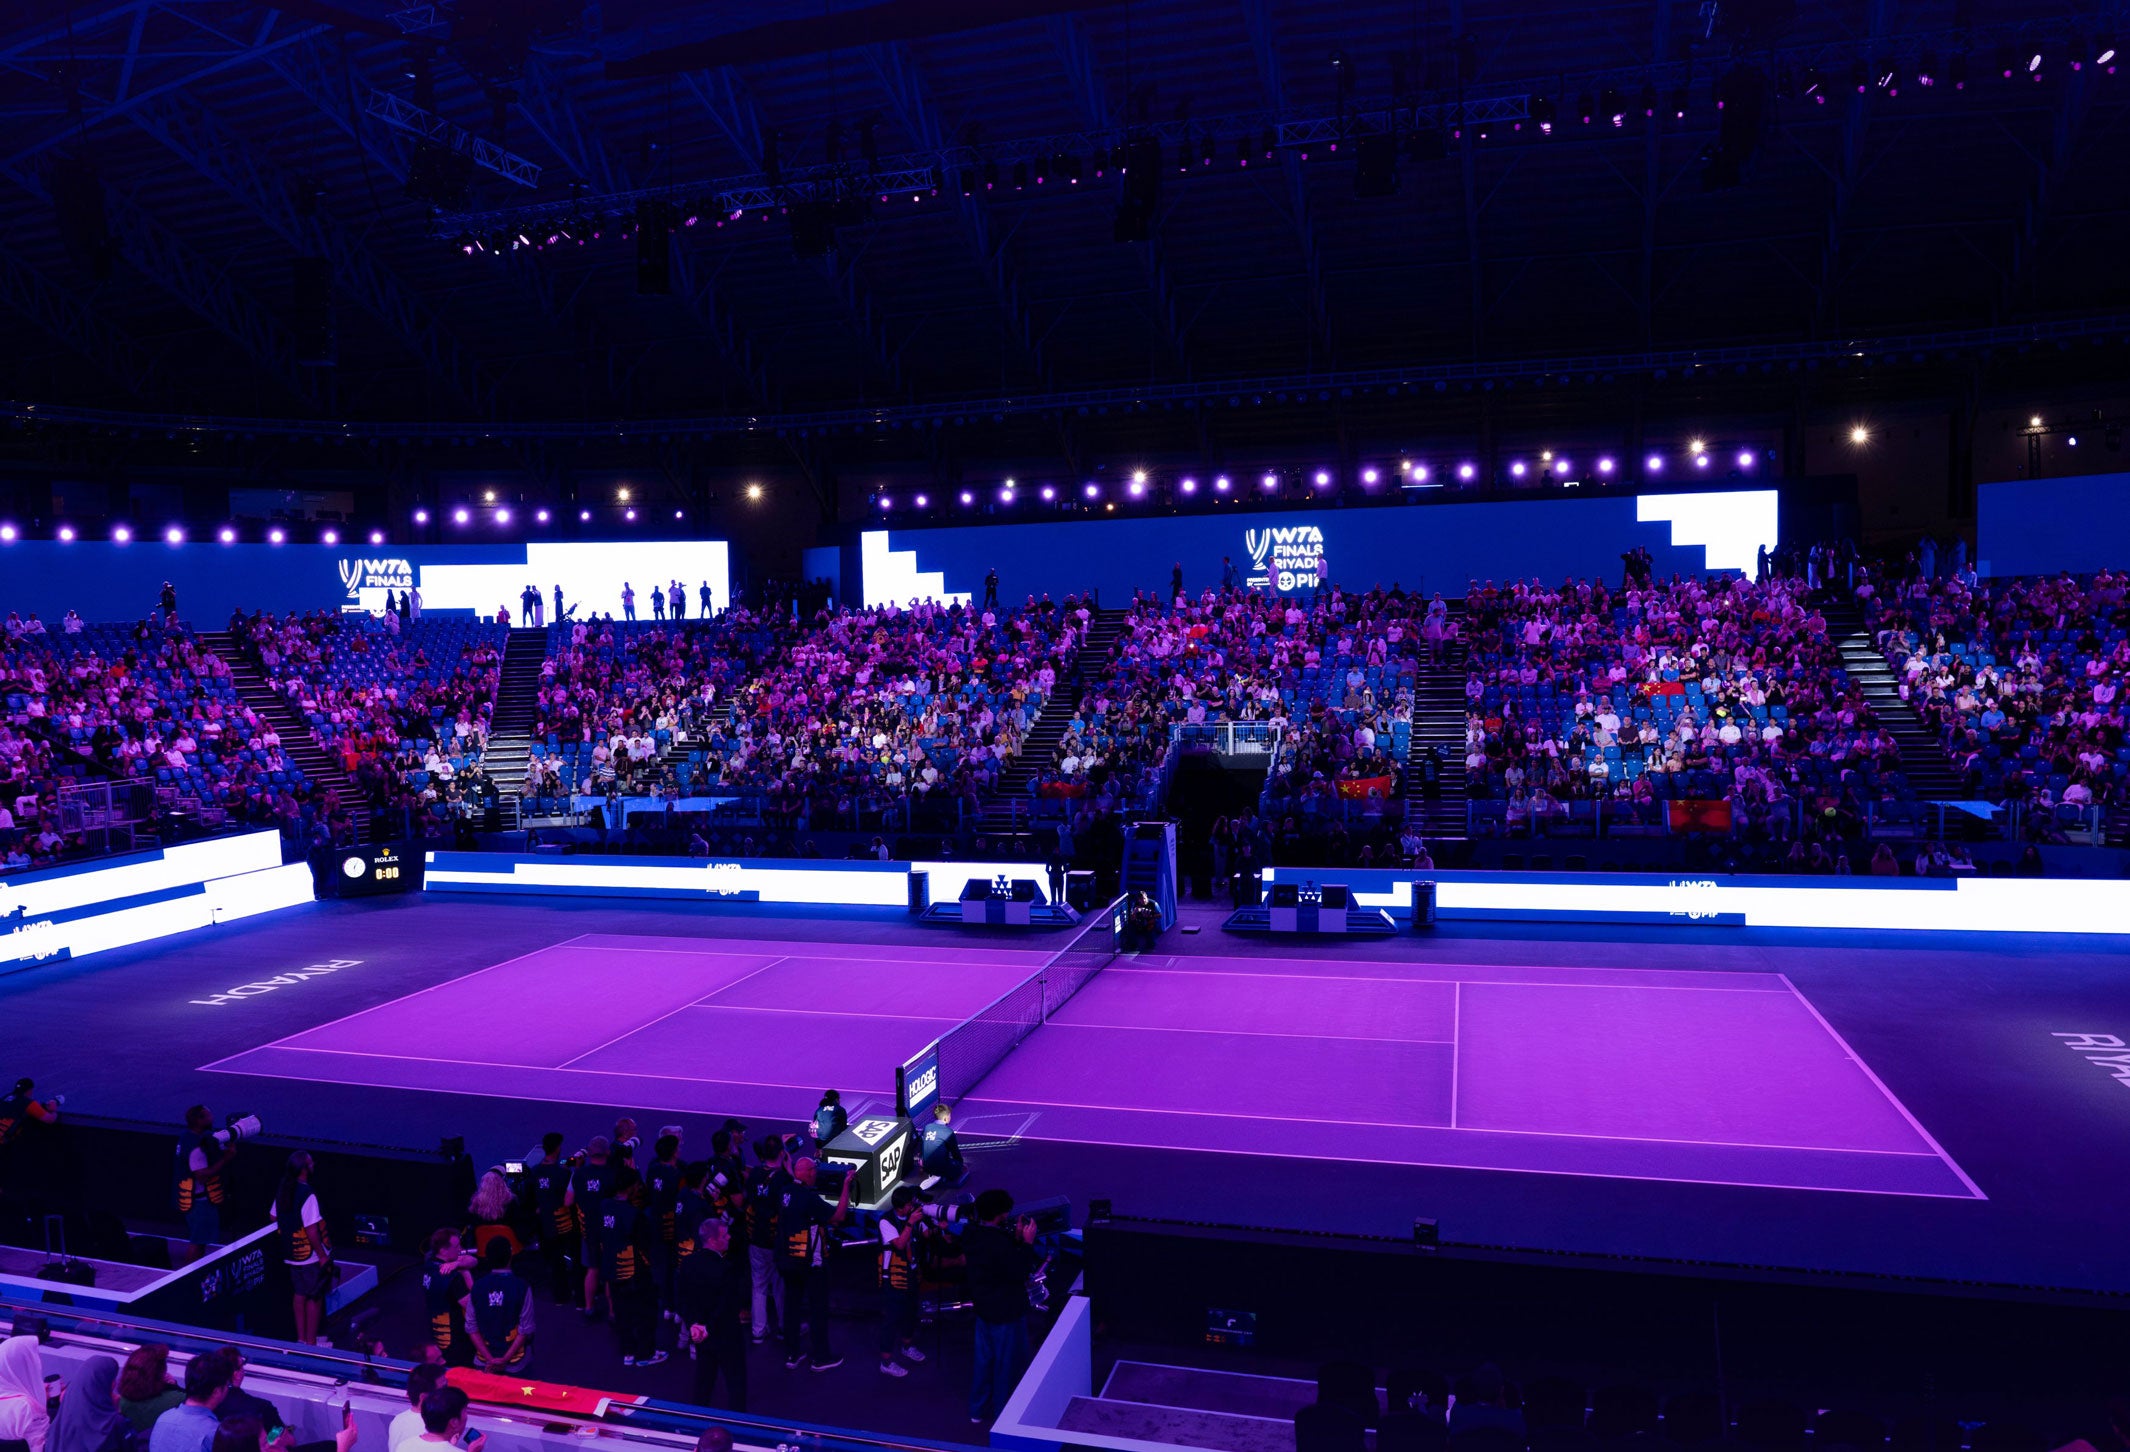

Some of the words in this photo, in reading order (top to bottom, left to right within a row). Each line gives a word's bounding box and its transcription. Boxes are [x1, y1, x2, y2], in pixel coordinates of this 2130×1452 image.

[1272, 526, 1323, 543] WTA
[1274, 543, 1323, 557] FINALS
[364, 559, 412, 574] WTA
[366, 576, 413, 586] FINALS
[374, 855, 399, 863] ROLEX
[375, 867, 399, 880] 0:00
[187, 959, 365, 1006] RIYADH
[909, 1065, 937, 1098] HOLOGIC
[858, 1121, 890, 1139] SAP
[881, 1146, 901, 1182] SAP
